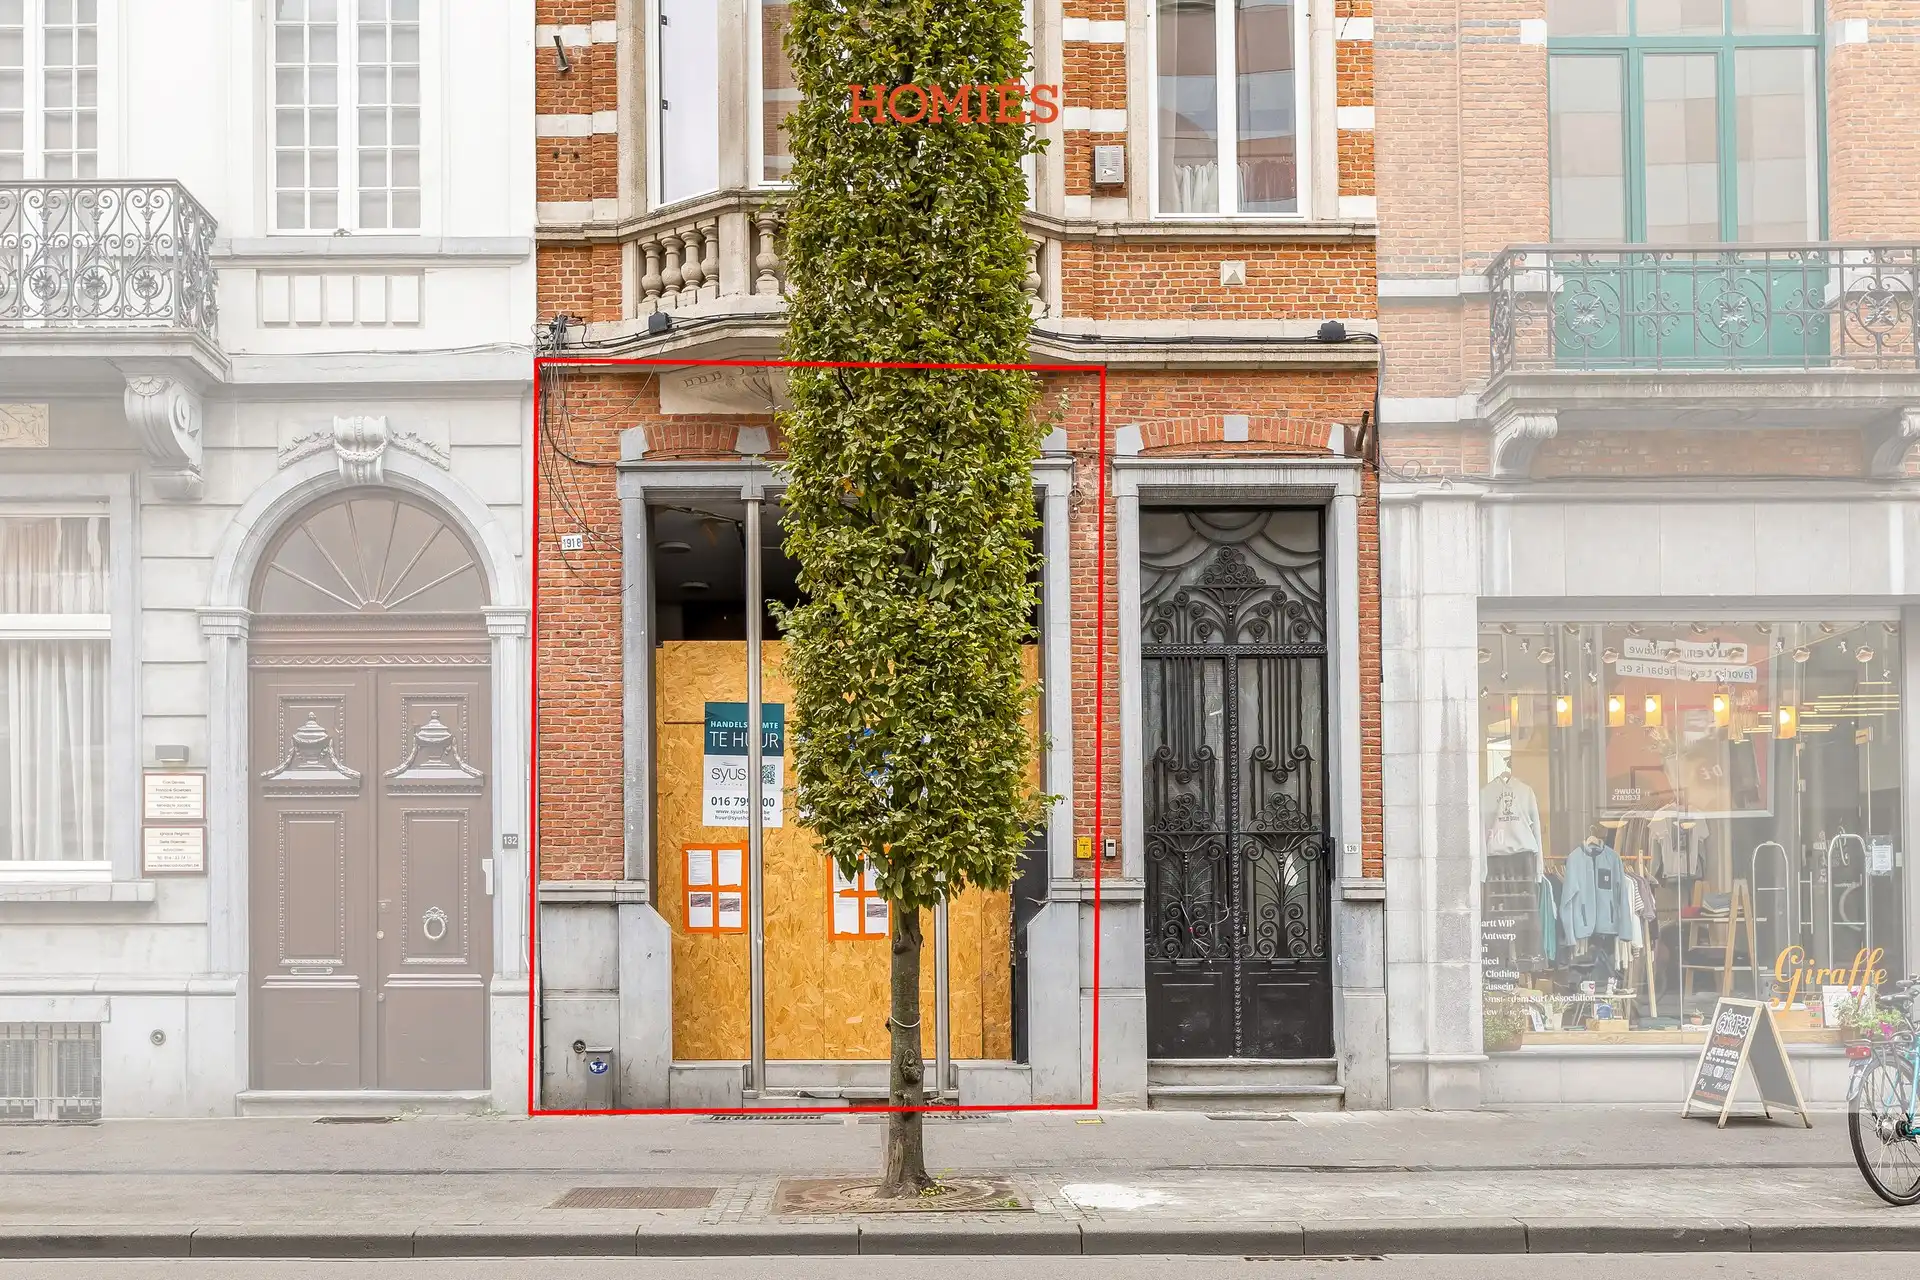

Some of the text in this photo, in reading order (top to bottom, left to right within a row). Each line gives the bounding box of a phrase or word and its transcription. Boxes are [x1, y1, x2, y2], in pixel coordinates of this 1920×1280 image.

[710, 721, 779, 729] HANDELSMTE
[709, 731, 728, 747] TE
[711, 796, 731, 806] 016
[503, 836, 518, 845] 132
[1497, 919, 1516, 928] WIP
[1481, 932, 1517, 942] Antwerp
[1485, 969, 1520, 979] Clothing
[1770, 945, 1888, 1013] Giraffe
[1530, 994, 1549, 1003] Surf
[1549, 993, 1596, 1003] Association
